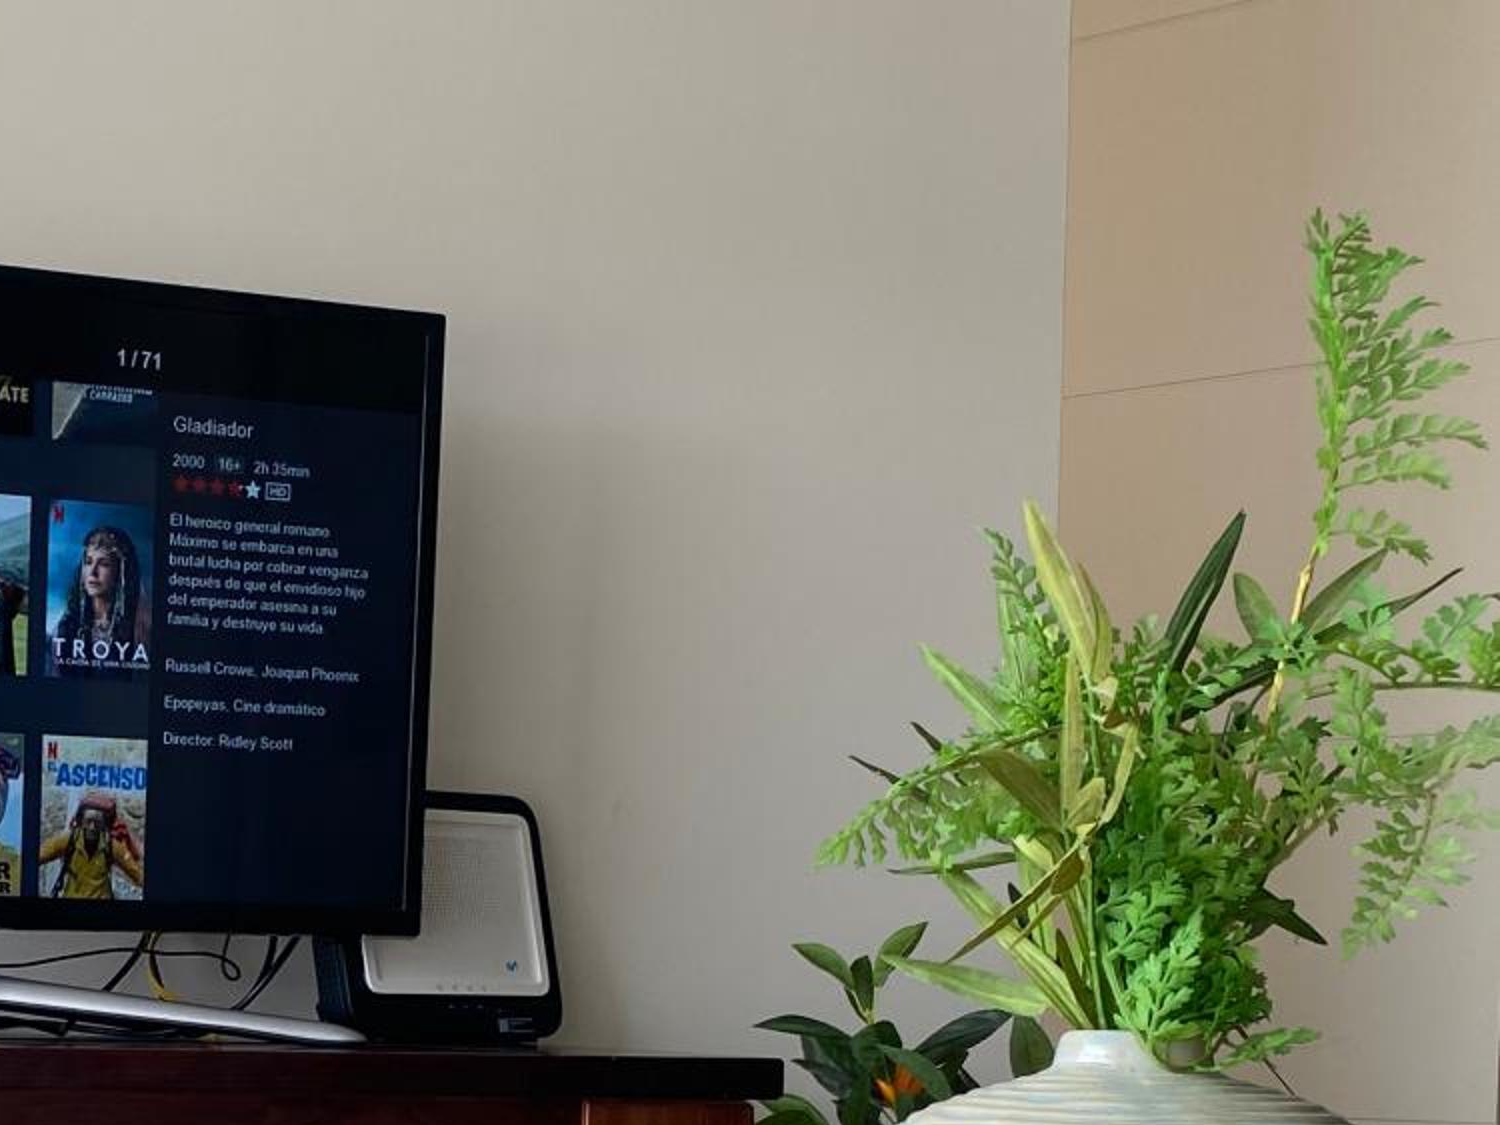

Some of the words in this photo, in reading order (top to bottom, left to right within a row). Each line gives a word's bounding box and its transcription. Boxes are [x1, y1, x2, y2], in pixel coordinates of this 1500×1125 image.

[173, 415, 254, 438] Gladiador
[172, 453, 205, 469] 2000
[253, 461, 269, 475] 2h
[268, 486, 288, 497] HD
[169, 513, 184, 527] El
[185, 515, 232, 531] heroico
[235, 519, 281, 536] general
[283, 524, 330, 539] romano
[169, 533, 219, 548] Máximo
[221, 538, 238, 550] se
[240, 539, 295, 556] embarca
[297, 546, 314, 557] en
[315, 547, 339, 558] una
[169, 553, 206, 568] brutal
[207, 555, 241, 571] lucha
[243, 560, 264, 575] por
[266, 561, 306, 575] cobrar
[309, 566, 369, 582] venganza
[168, 573, 222, 590] después
[224, 576, 241, 591] de
[243, 579, 267, 594] que
[269, 582, 282, 594] el
[283, 584, 343, 598] envidioso
[345, 586, 366, 602] hijo
[167, 592, 187, 606] del
[190, 595, 258, 612] emperador
[259, 600, 309, 615] asesina
[311, 604, 320, 615] a
[321, 604, 338, 616] su
[167, 611, 210, 627] familia
[211, 616, 224, 631] y
[222, 616, 277, 634] destruye
[279, 621, 296, 633] su
[52, 636, 149, 663] TROYA
[164, 657, 211, 675] Russell
[311, 667, 360, 683] Phoenix
[233, 699, 261, 713] Cine
[263, 700, 327, 718] dramático
[219, 733, 257, 751] Ridley
[260, 736, 294, 750] Scott
[56, 763, 148, 791] ASCENSO
